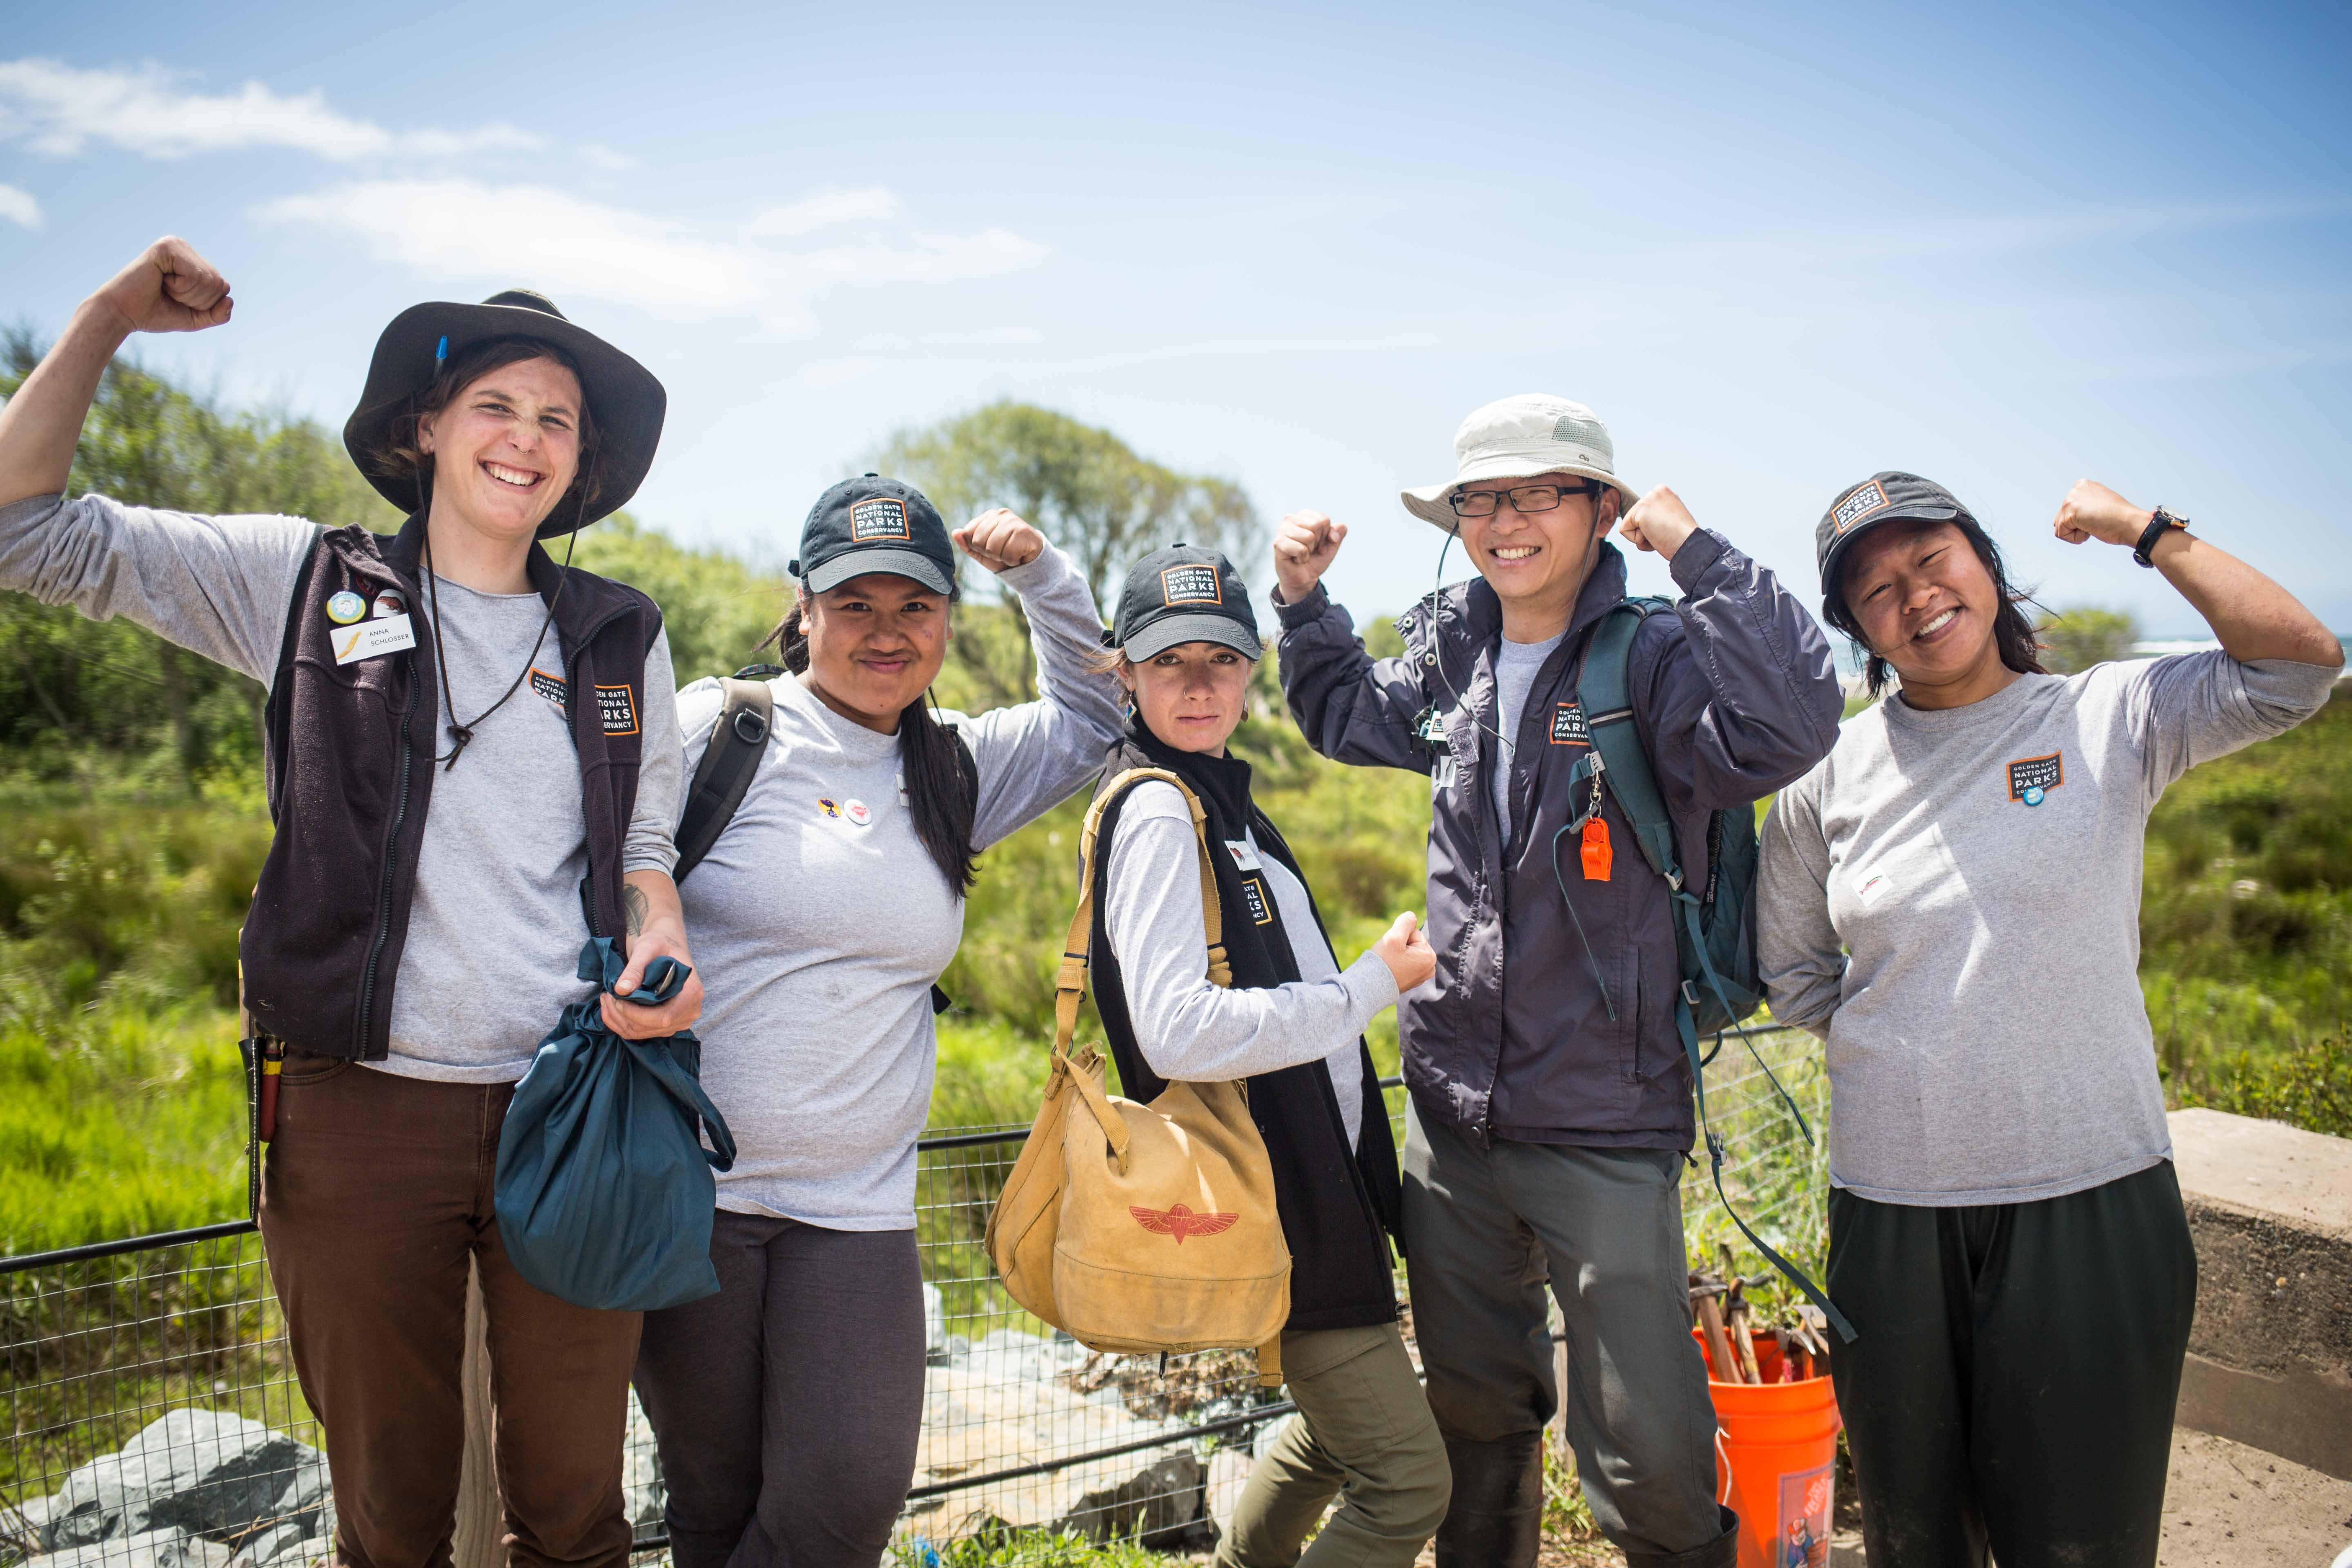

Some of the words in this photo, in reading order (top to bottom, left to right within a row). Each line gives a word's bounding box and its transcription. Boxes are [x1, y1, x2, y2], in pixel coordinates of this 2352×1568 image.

[1836, 495, 1858, 514] GOLDEN
[1859, 486, 1875, 497] GATE
[1838, 491, 1877, 518] NATIONAL
[855, 505, 882, 514] GOLDEN
[1839, 494, 1880, 523] PARKS
[1842, 500, 1881, 528] CONSERVANCY
[856, 510, 902, 520] NATIONAL
[857, 517, 903, 529] PARKS
[858, 527, 903, 535] CONSERVANCY
[1167, 570, 1194, 579] GOLDEN
[1168, 576, 1213, 585] NATIONAL
[1169, 582, 1214, 593] PARKS
[370, 629, 389, 637] ANNA
[371, 633, 409, 646] SCHLOSSER
[535, 677, 559, 688] GOLDEN
[535, 682, 566, 697] NATION
[535, 687, 565, 704] PARK
[601, 708, 630, 720] RKS
[1556, 722, 1585, 732] PAR
[2014, 765, 2057, 778] NATIONAL
[2015, 771, 2057, 788] PARKS
